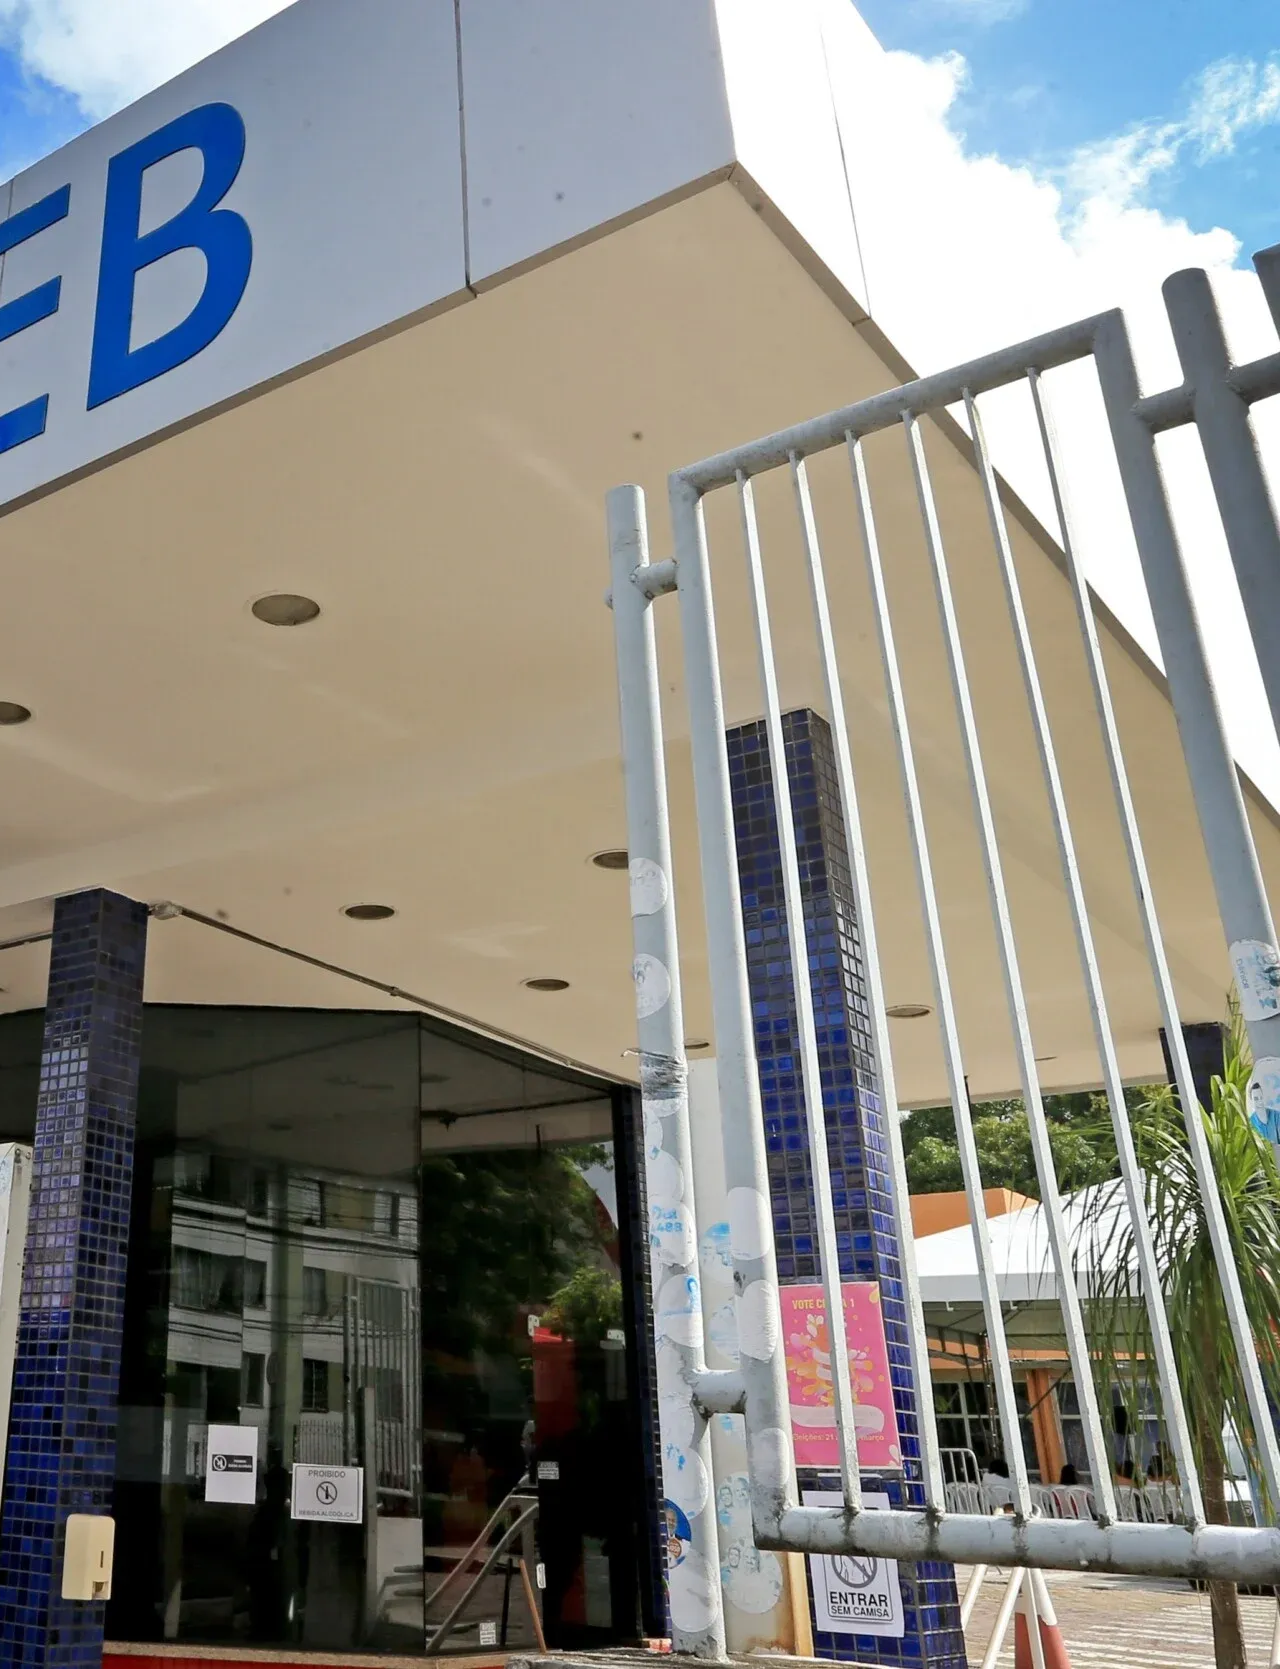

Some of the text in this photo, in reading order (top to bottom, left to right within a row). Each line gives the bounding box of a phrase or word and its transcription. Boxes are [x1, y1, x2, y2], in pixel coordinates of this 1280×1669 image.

[792, 1298, 814, 1310] VOTE
[850, 1298, 855, 1308] 1
[308, 1469, 346, 1479] PROIBIDO
[830, 1591, 888, 1607] ENTRAR
[831, 1604, 889, 1617] SEM CAMISA
